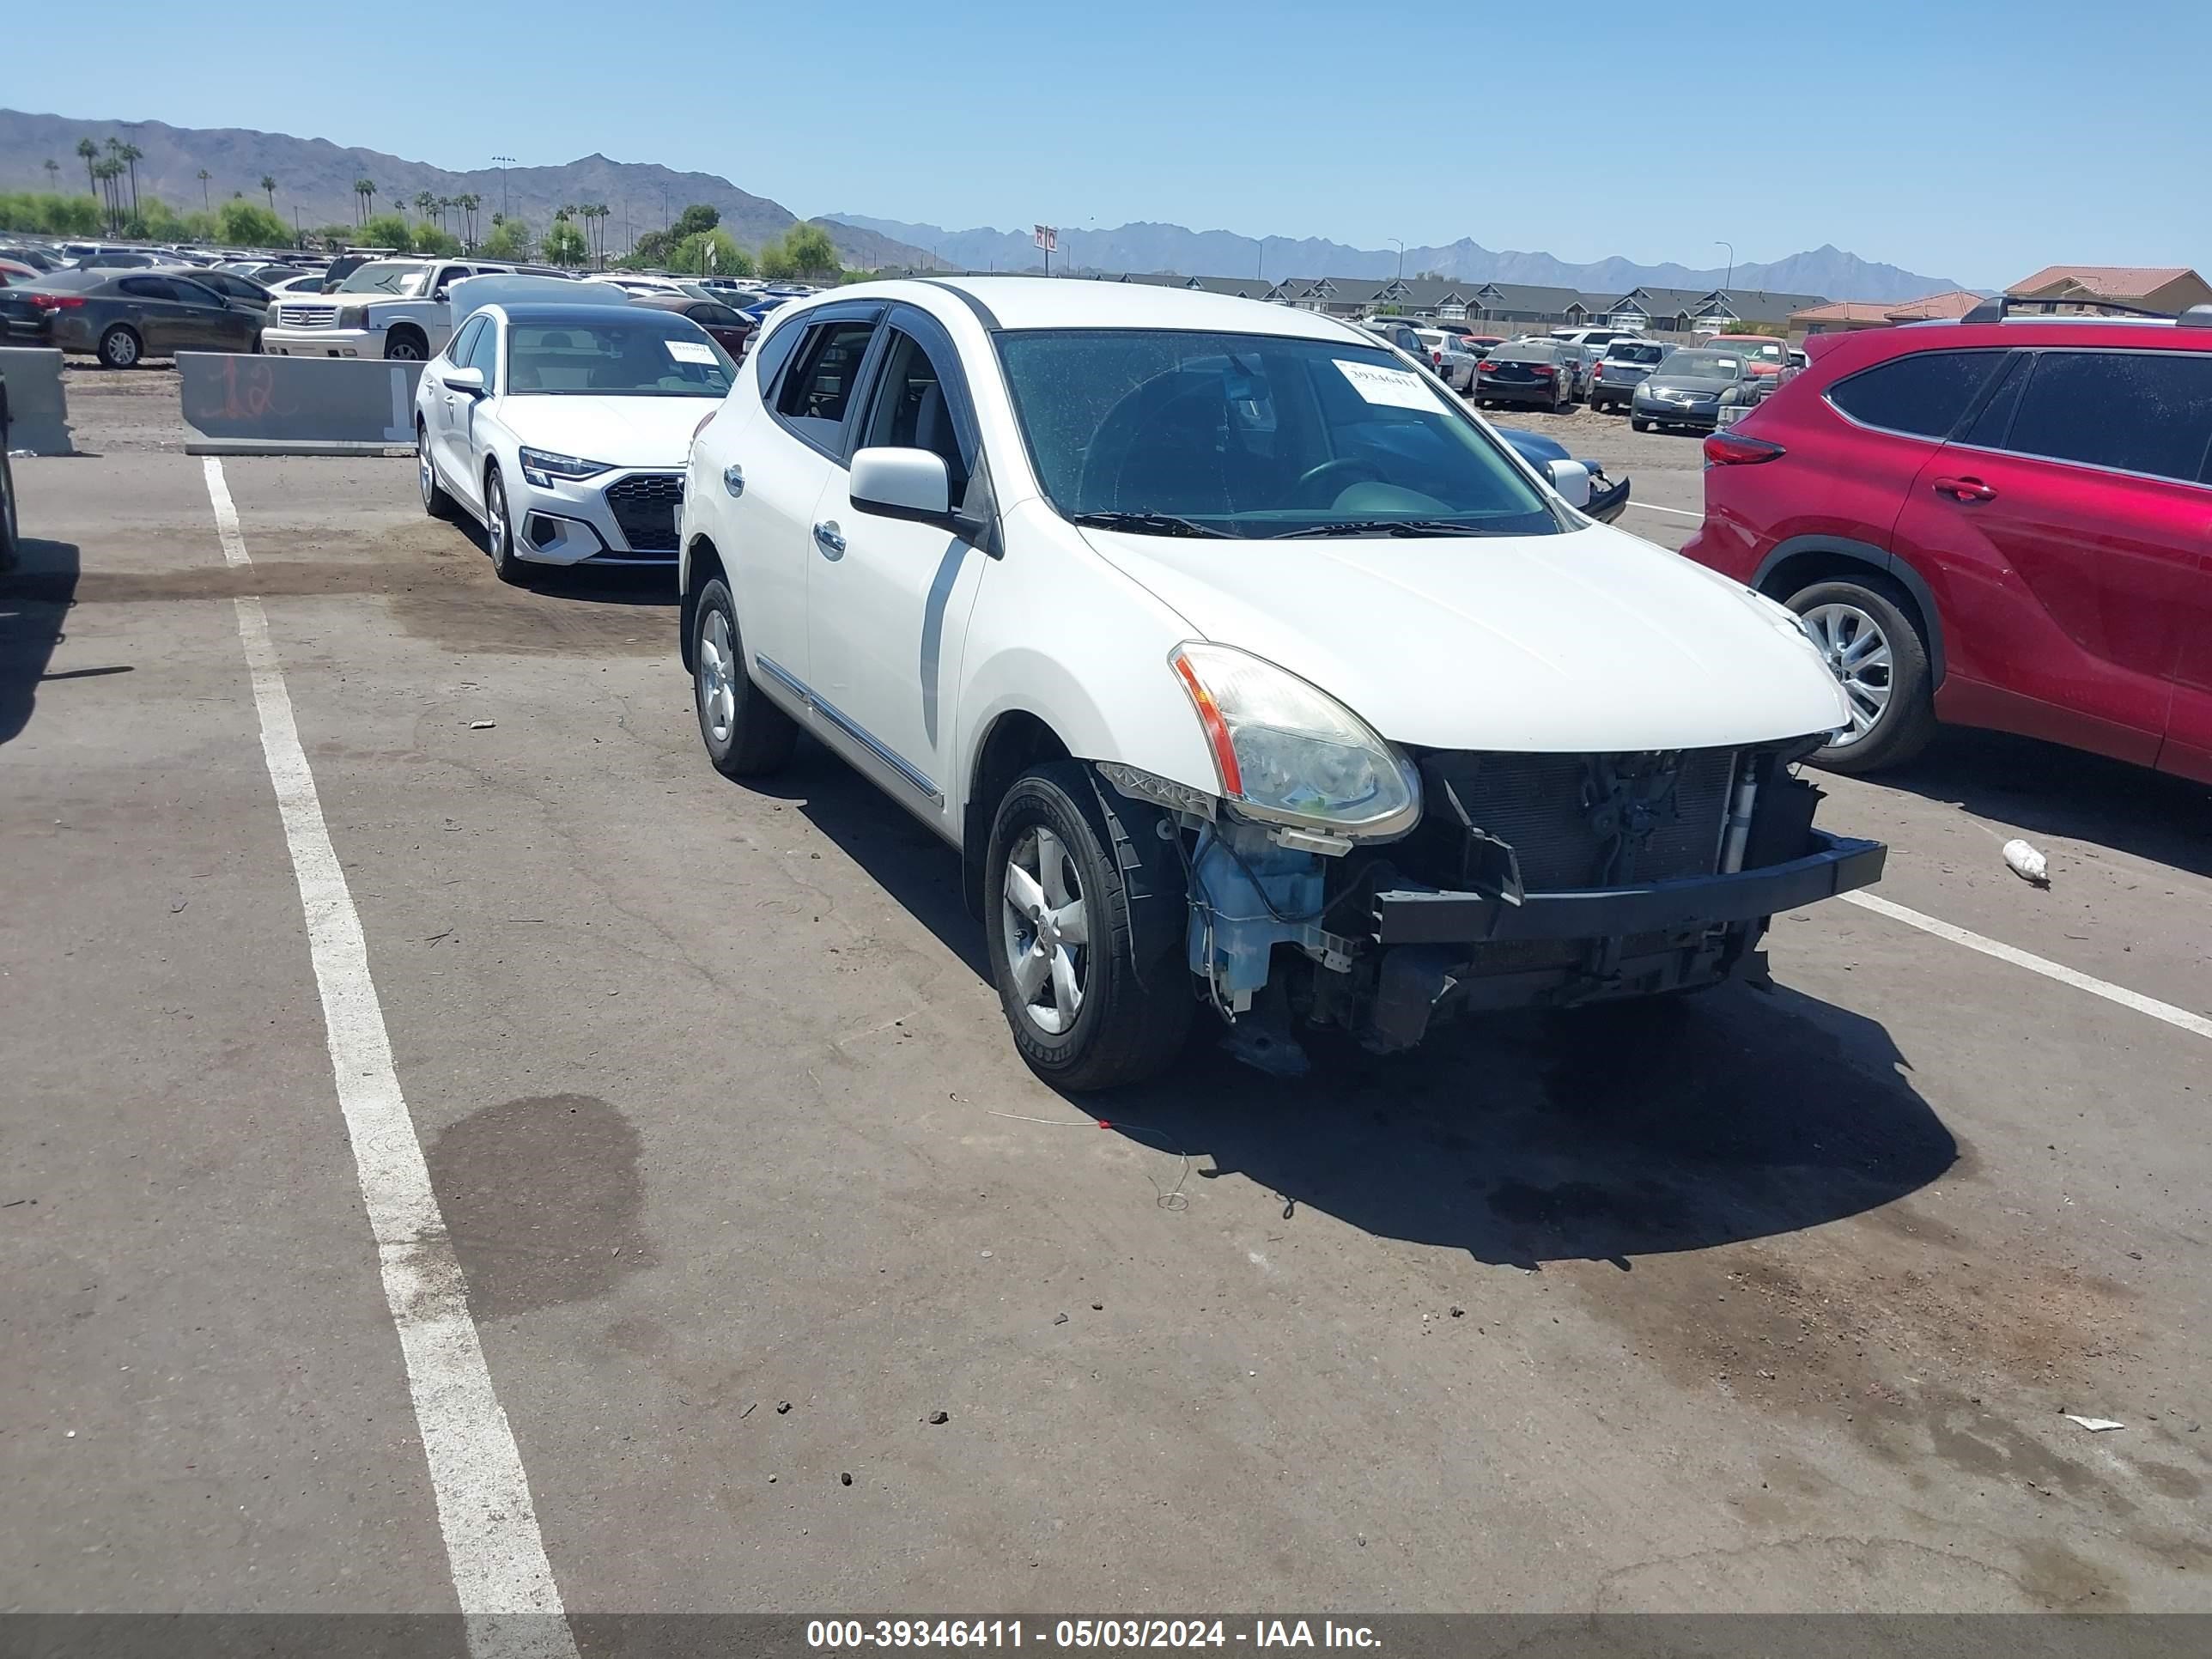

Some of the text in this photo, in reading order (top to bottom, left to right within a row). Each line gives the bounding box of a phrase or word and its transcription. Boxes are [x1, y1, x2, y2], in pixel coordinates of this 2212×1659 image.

[1036, 228, 1043, 246] R
[1048, 232, 1056, 250] Q
[1349, 370, 1418, 388] 39346411
